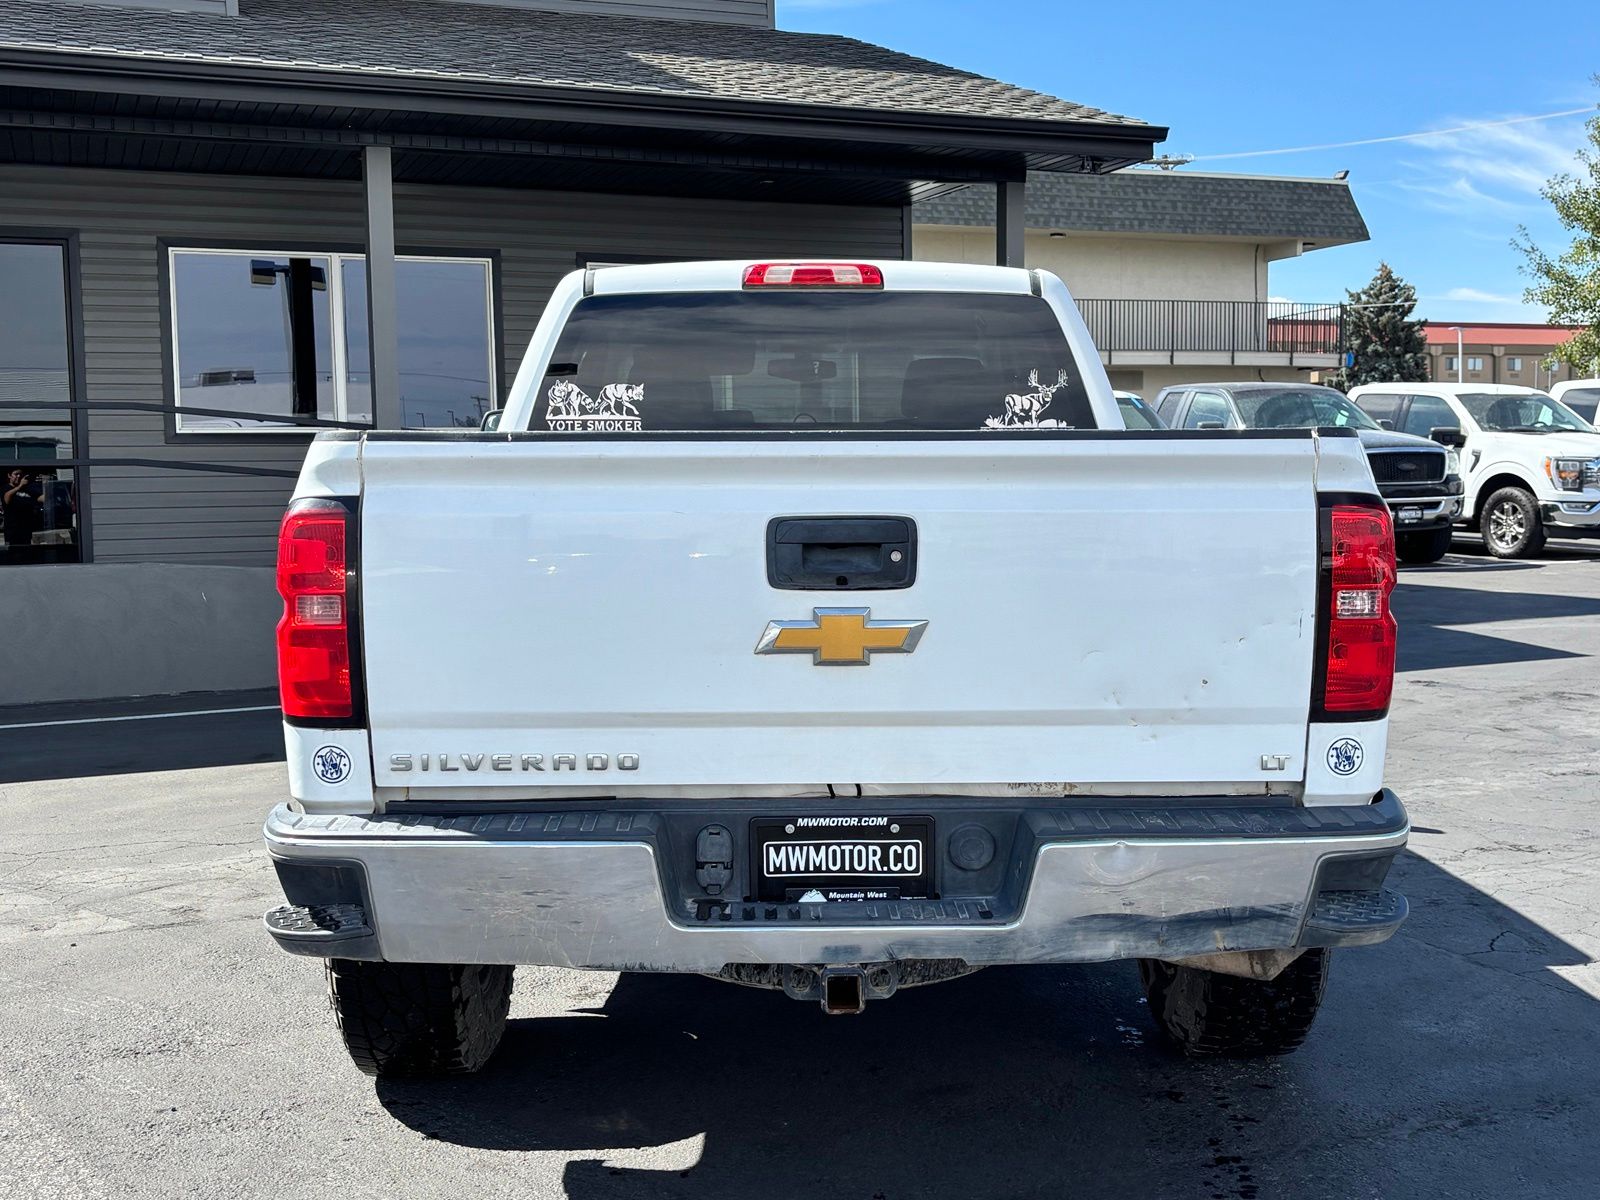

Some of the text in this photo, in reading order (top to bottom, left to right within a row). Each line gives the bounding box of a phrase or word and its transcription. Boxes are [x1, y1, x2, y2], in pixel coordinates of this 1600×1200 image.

[547, 420, 642, 431] YOTE SMOKER
[390, 753, 640, 772] SILVERADO
[1261, 754, 1291, 771] LT
[797, 817, 888, 827] MWMOTOR.COM
[769, 845, 917, 872] MWMOTOR.CO
[828, 891, 865, 899] Mountain
